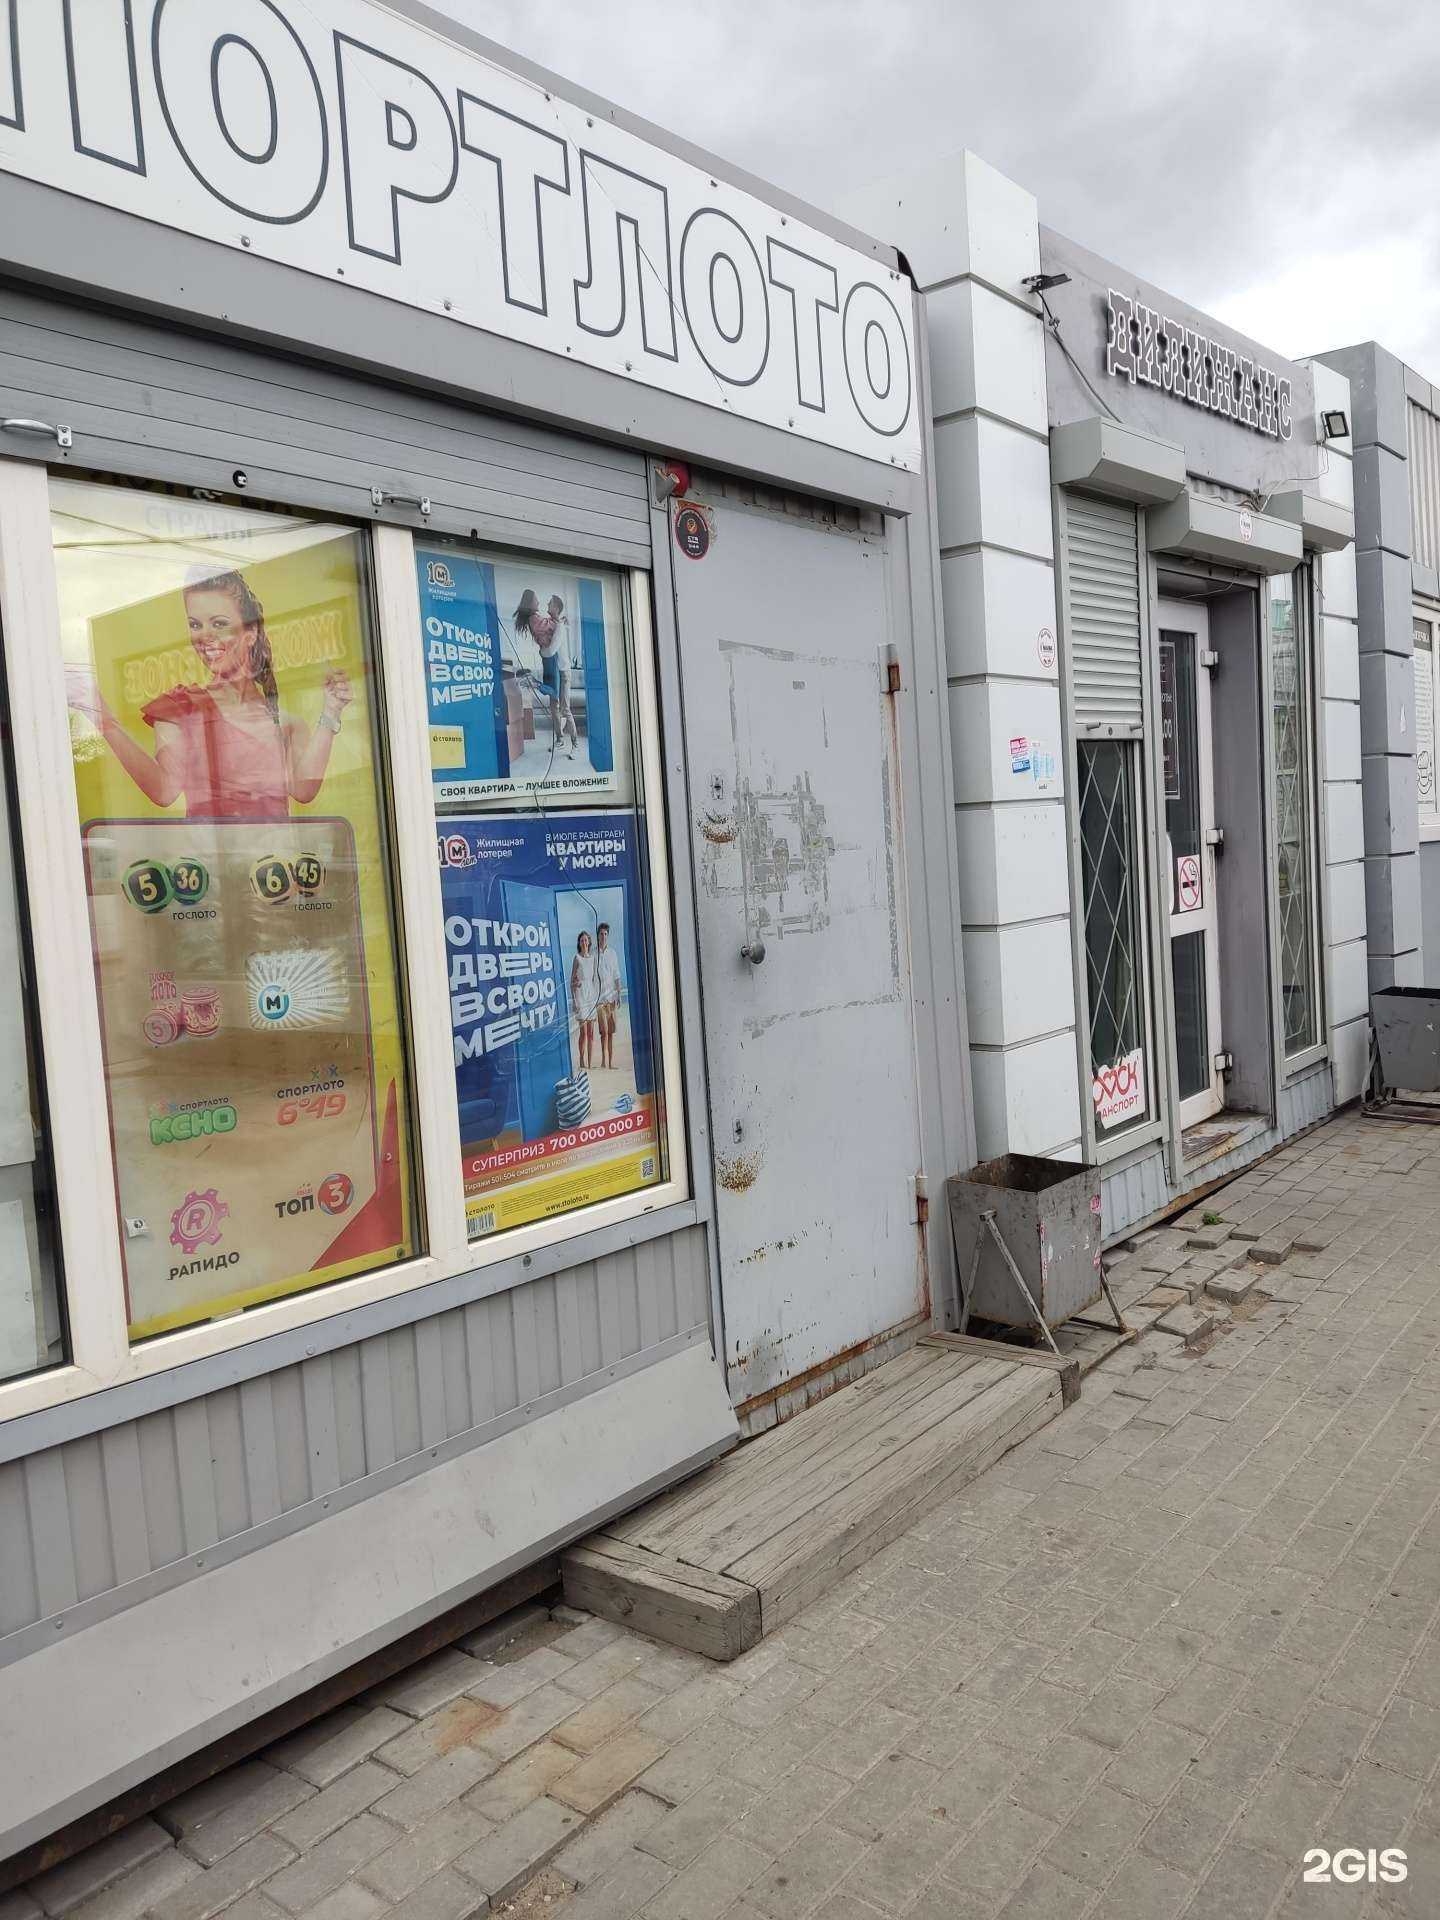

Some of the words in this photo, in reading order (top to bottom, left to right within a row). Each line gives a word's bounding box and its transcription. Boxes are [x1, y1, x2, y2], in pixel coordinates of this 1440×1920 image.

[1107, 287, 1292, 441] ДИЛИЖАНС
[426, 616, 492, 650] ОТКРОЙ
[428, 639, 493, 665] ДВЕРЬ
[430, 663, 451, 682] В
[451, 664, 494, 682] СВОЮ
[432, 682, 495, 706] МЕЧТУ
[440, 787, 466, 797] СВОЯ
[468, 783, 516, 795] КВАРТИРА
[525, 778, 561, 791] ЛУЧШЕЕ
[562, 777, 609, 789] ВЛОЖЕНИЕ!
[476, 837, 525, 849] Жилищная
[546, 839, 626, 856] КВАРТИРЫ
[553, 832, 578, 841] ИЮЛЕ
[579, 830, 625, 840] РАЗЫГРАЕМ
[477, 849, 513, 860] лотерея
[559, 857, 569, 871] У
[572, 853, 618, 870] МОРЯ!
[138, 873, 159, 902] 5
[175, 866, 199, 890] 36
[266, 867, 283, 894] 6
[298, 862, 318, 885] 45
[172, 909, 217, 920] ГОСЛОТО
[294, 901, 333, 911] ГОСЛОТО
[444, 915, 551, 948] ОТКРОЙ
[449, 951, 553, 992] ДВЕРЬ
[450, 991, 486, 1028] В
[486, 977, 556, 1015] СВОЮ
[454, 1001, 557, 1069] МЕЧТУ
[277, 1079, 345, 1099] СПОРТЛОТО
[179, 1097, 230, 1111] СПОРТЛОТО
[472, 1142, 546, 1173] СУПЕРПРИЗ
[549, 1134, 577, 1151] 700
[580, 1126, 606, 1143] 000
[608, 1118, 634, 1134] 000
[275, 1194, 315, 1218] ТОП
[328, 1182, 346, 1208] 3
[187, 1208, 206, 1231] R
[168, 1251, 240, 1281] РАПИДО
